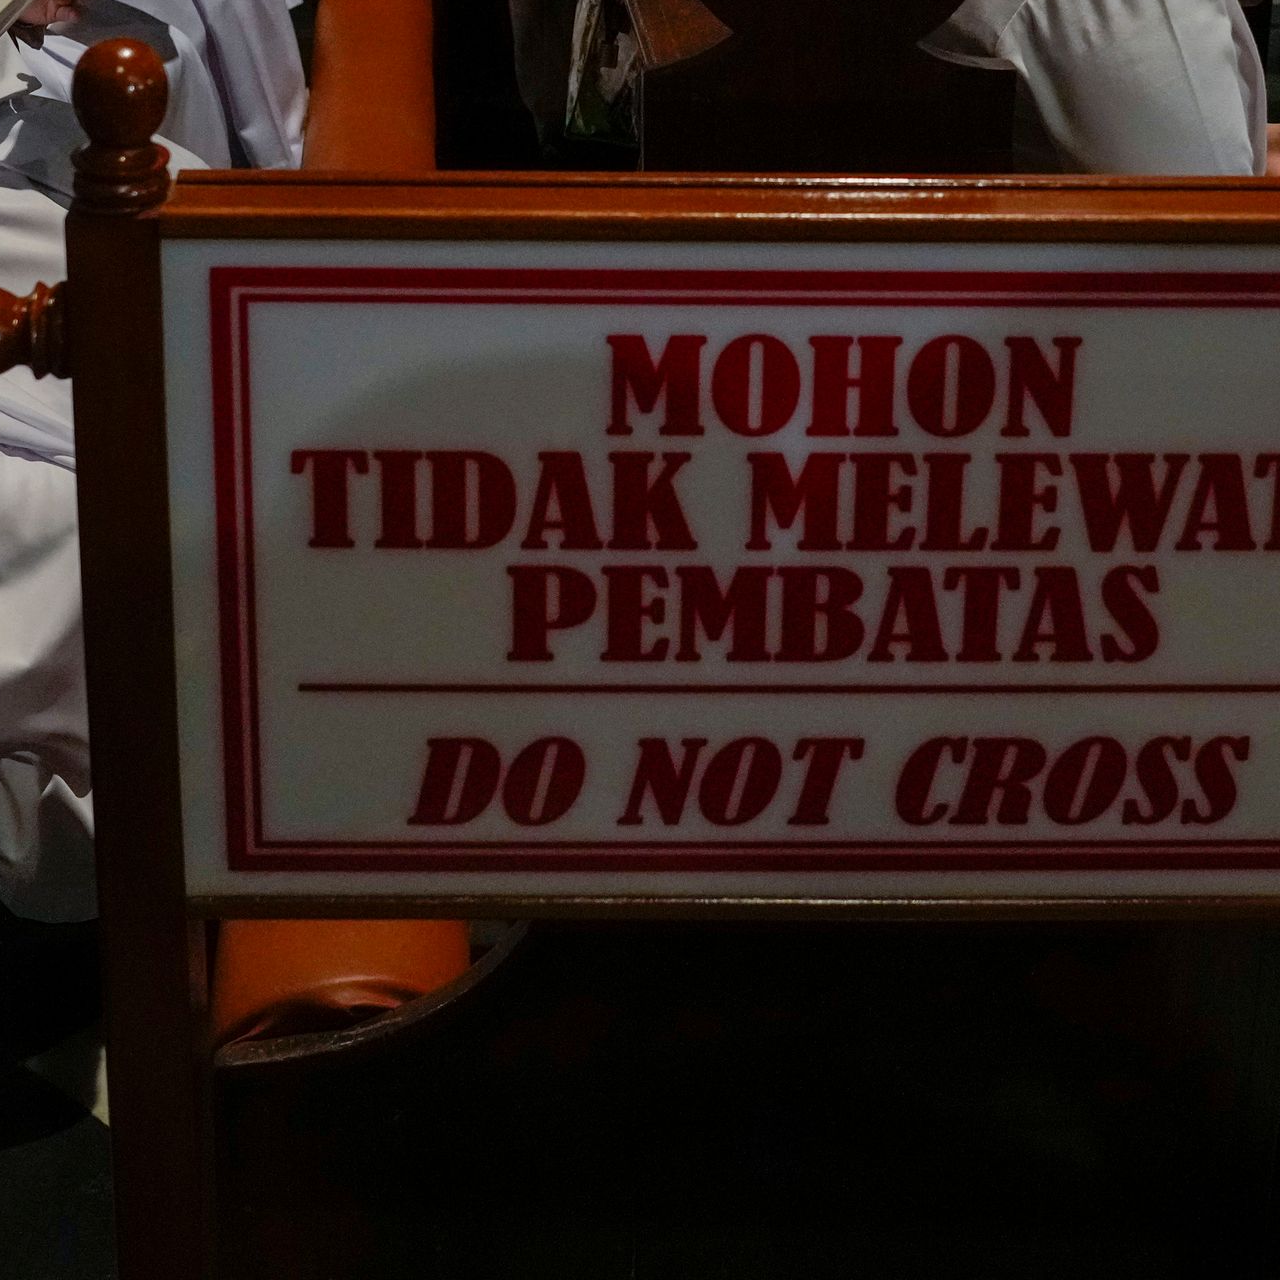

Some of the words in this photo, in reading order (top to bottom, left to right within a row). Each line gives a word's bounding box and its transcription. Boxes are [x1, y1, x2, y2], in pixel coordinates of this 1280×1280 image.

[605, 334, 1083, 439] MOHON
[291, 449, 698, 552] TIDAK
[507, 564, 1160, 663] PEMBATAS
[407, 736, 586, 827] DO
[617, 737, 865, 827] NOT
[895, 736, 1250, 827] CROSS
